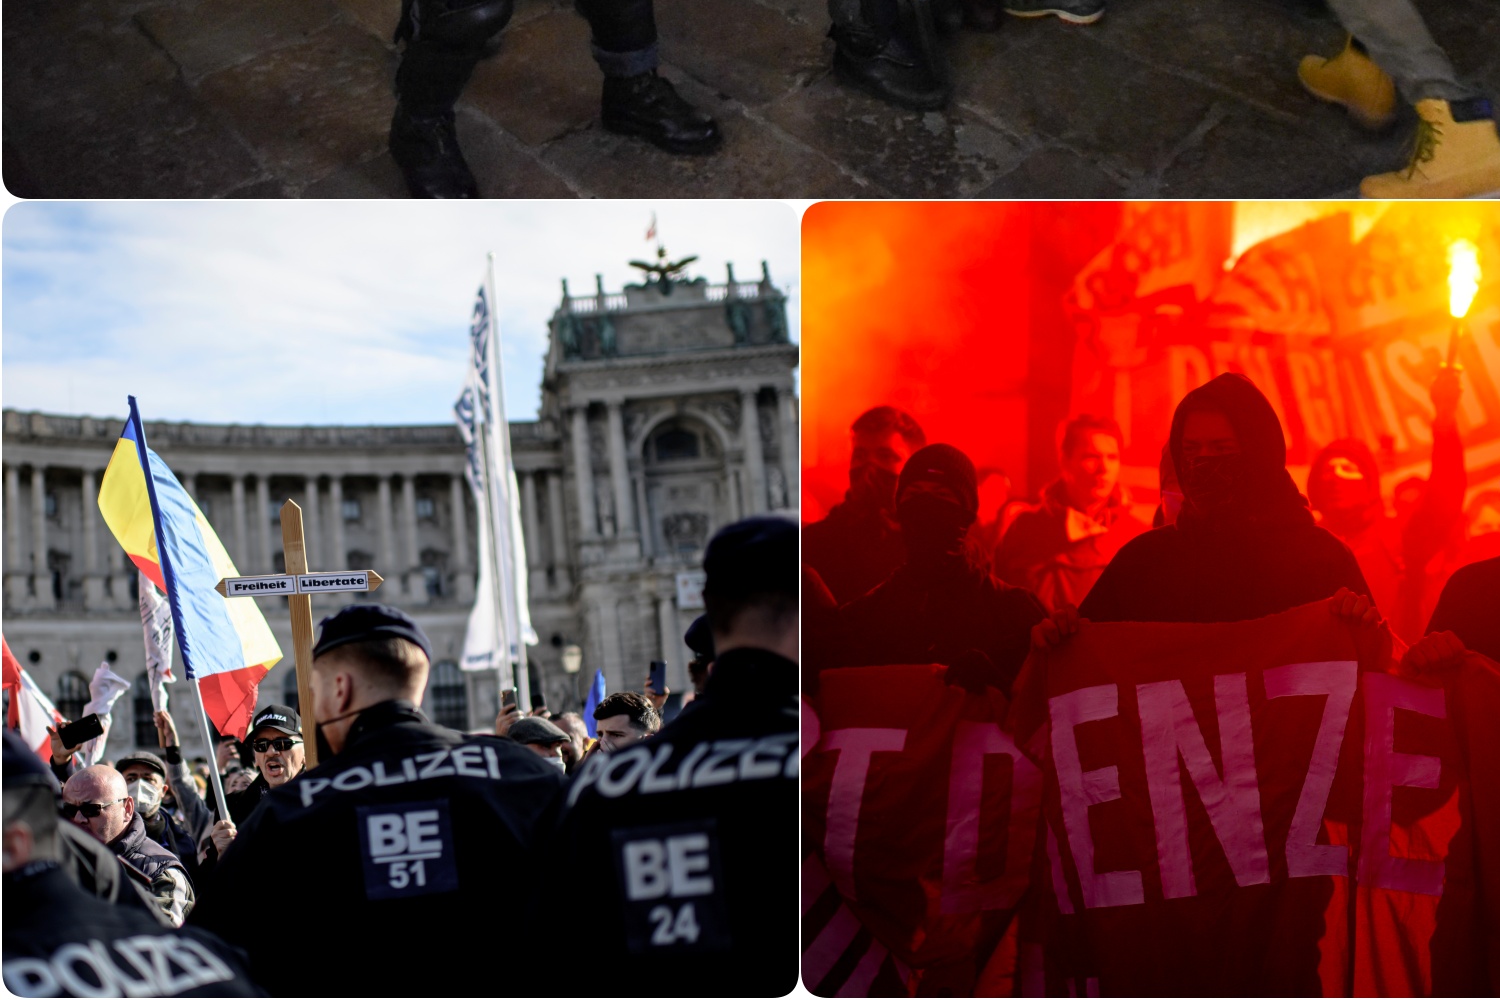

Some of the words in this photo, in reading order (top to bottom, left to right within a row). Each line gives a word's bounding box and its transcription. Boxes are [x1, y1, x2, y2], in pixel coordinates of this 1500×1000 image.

[234, 581, 287, 591] Freiheit
[301, 577, 365, 588] Libertate
[299, 745, 501, 808] POLIZEI
[366, 809, 443, 858] BE
[389, 860, 426, 889] 51
[622, 832, 714, 900] BE
[648, 902, 701, 946] 24
[2, 934, 235, 998] POLIZEI
